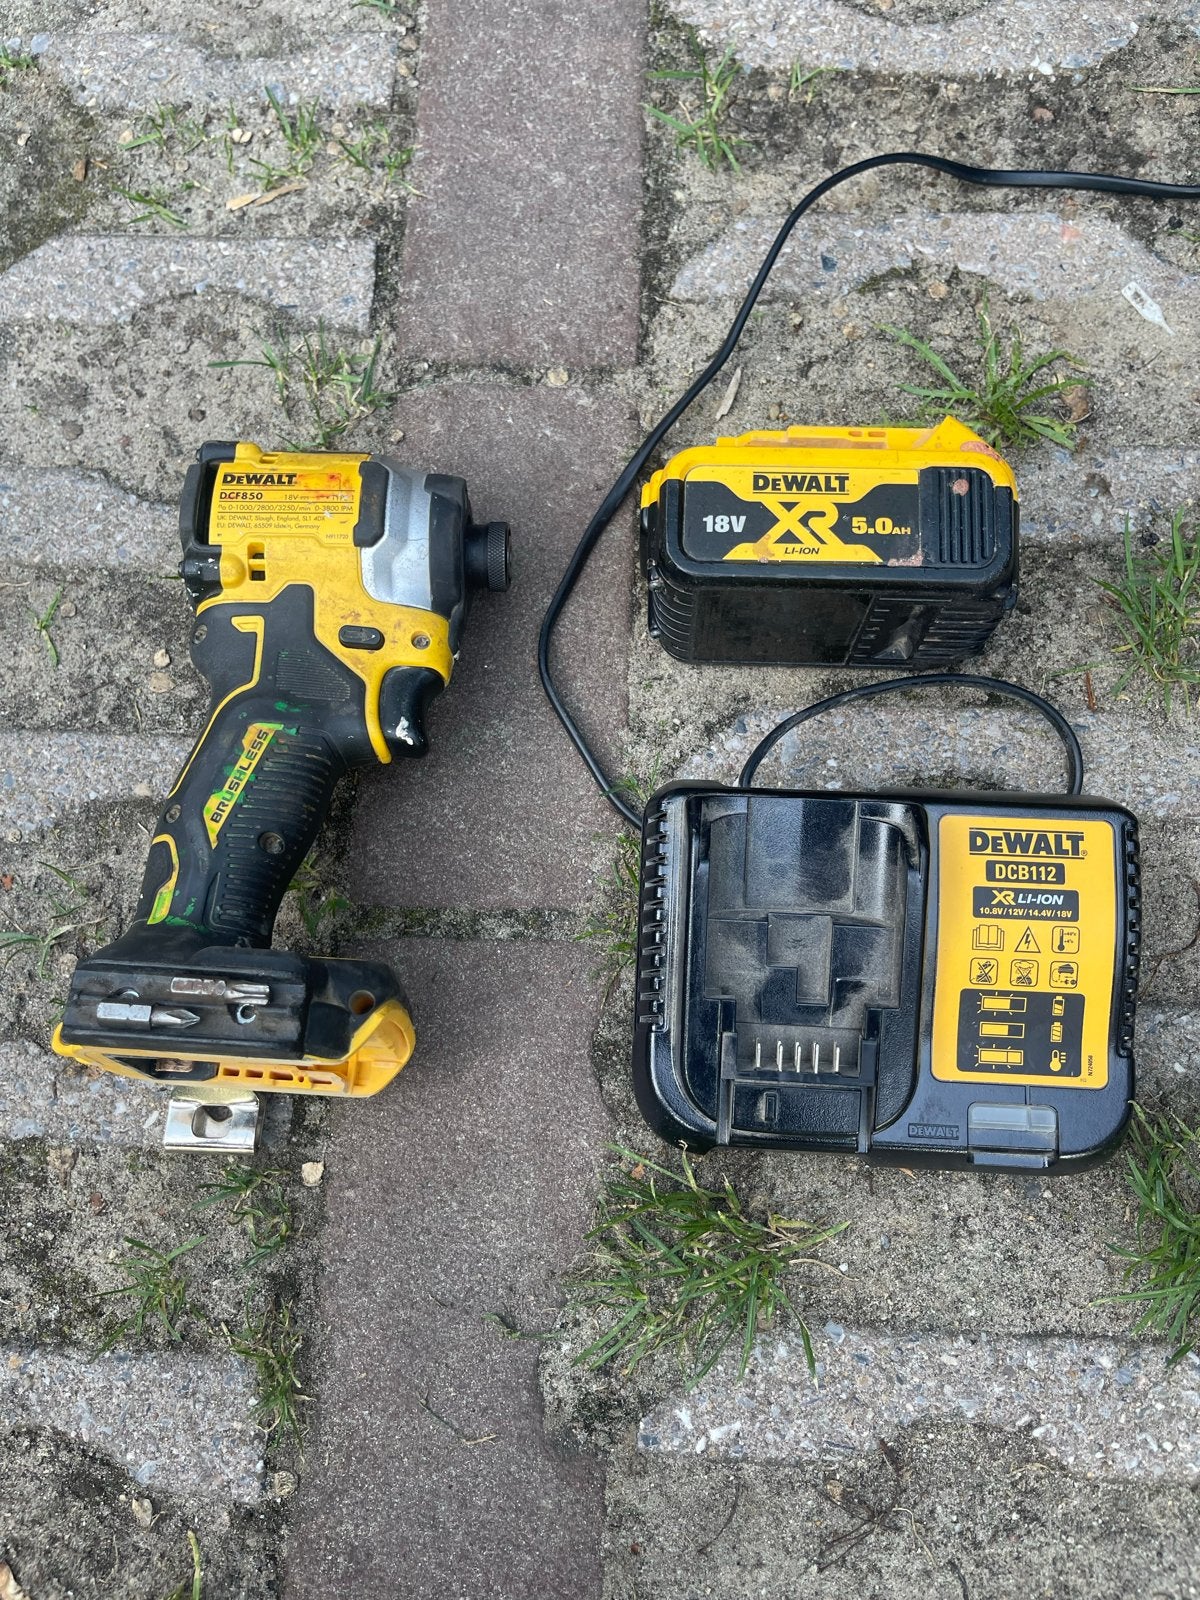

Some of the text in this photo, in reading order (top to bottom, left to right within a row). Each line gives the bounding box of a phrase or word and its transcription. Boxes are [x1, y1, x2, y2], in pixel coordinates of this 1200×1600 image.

[219, 491, 263, 500] DCF850
[702, 515, 747, 533] 18V
[757, 501, 844, 544] XR
[784, 546, 820, 555] LI-ION
[209, 728, 270, 824] BRUSHLESS
[995, 864, 1057, 882] DCB112
[990, 890, 1064, 905] XR LI-ION
